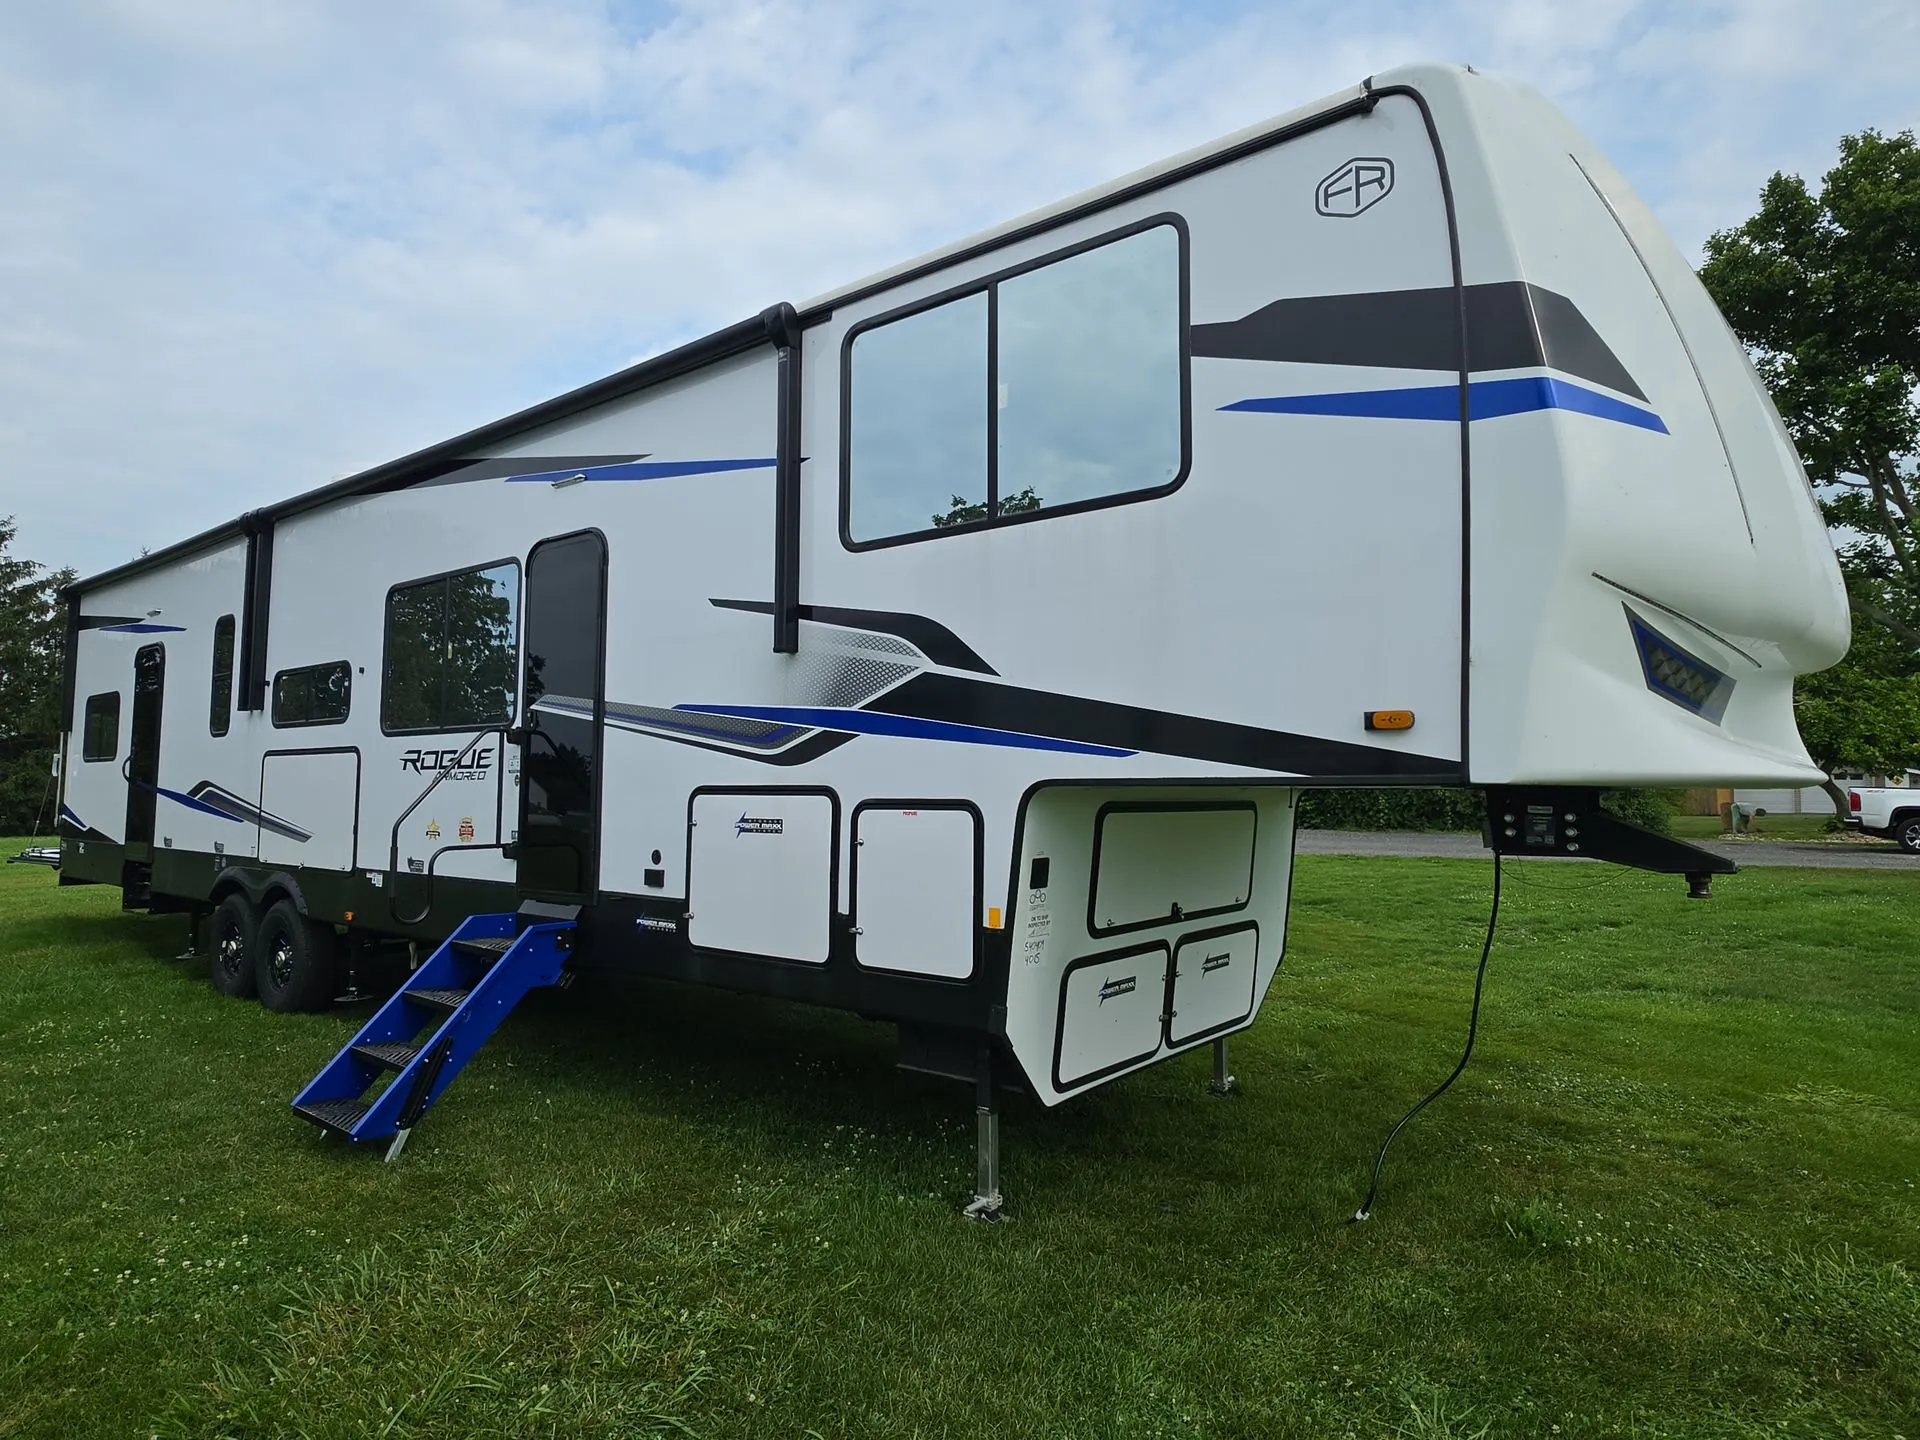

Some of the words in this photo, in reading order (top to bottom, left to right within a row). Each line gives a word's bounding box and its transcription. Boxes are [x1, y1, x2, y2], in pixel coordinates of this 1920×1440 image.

[400, 748, 495, 775] ROGUE
[636, 918, 658, 927] POWER
[658, 921, 677, 929] MAXX
